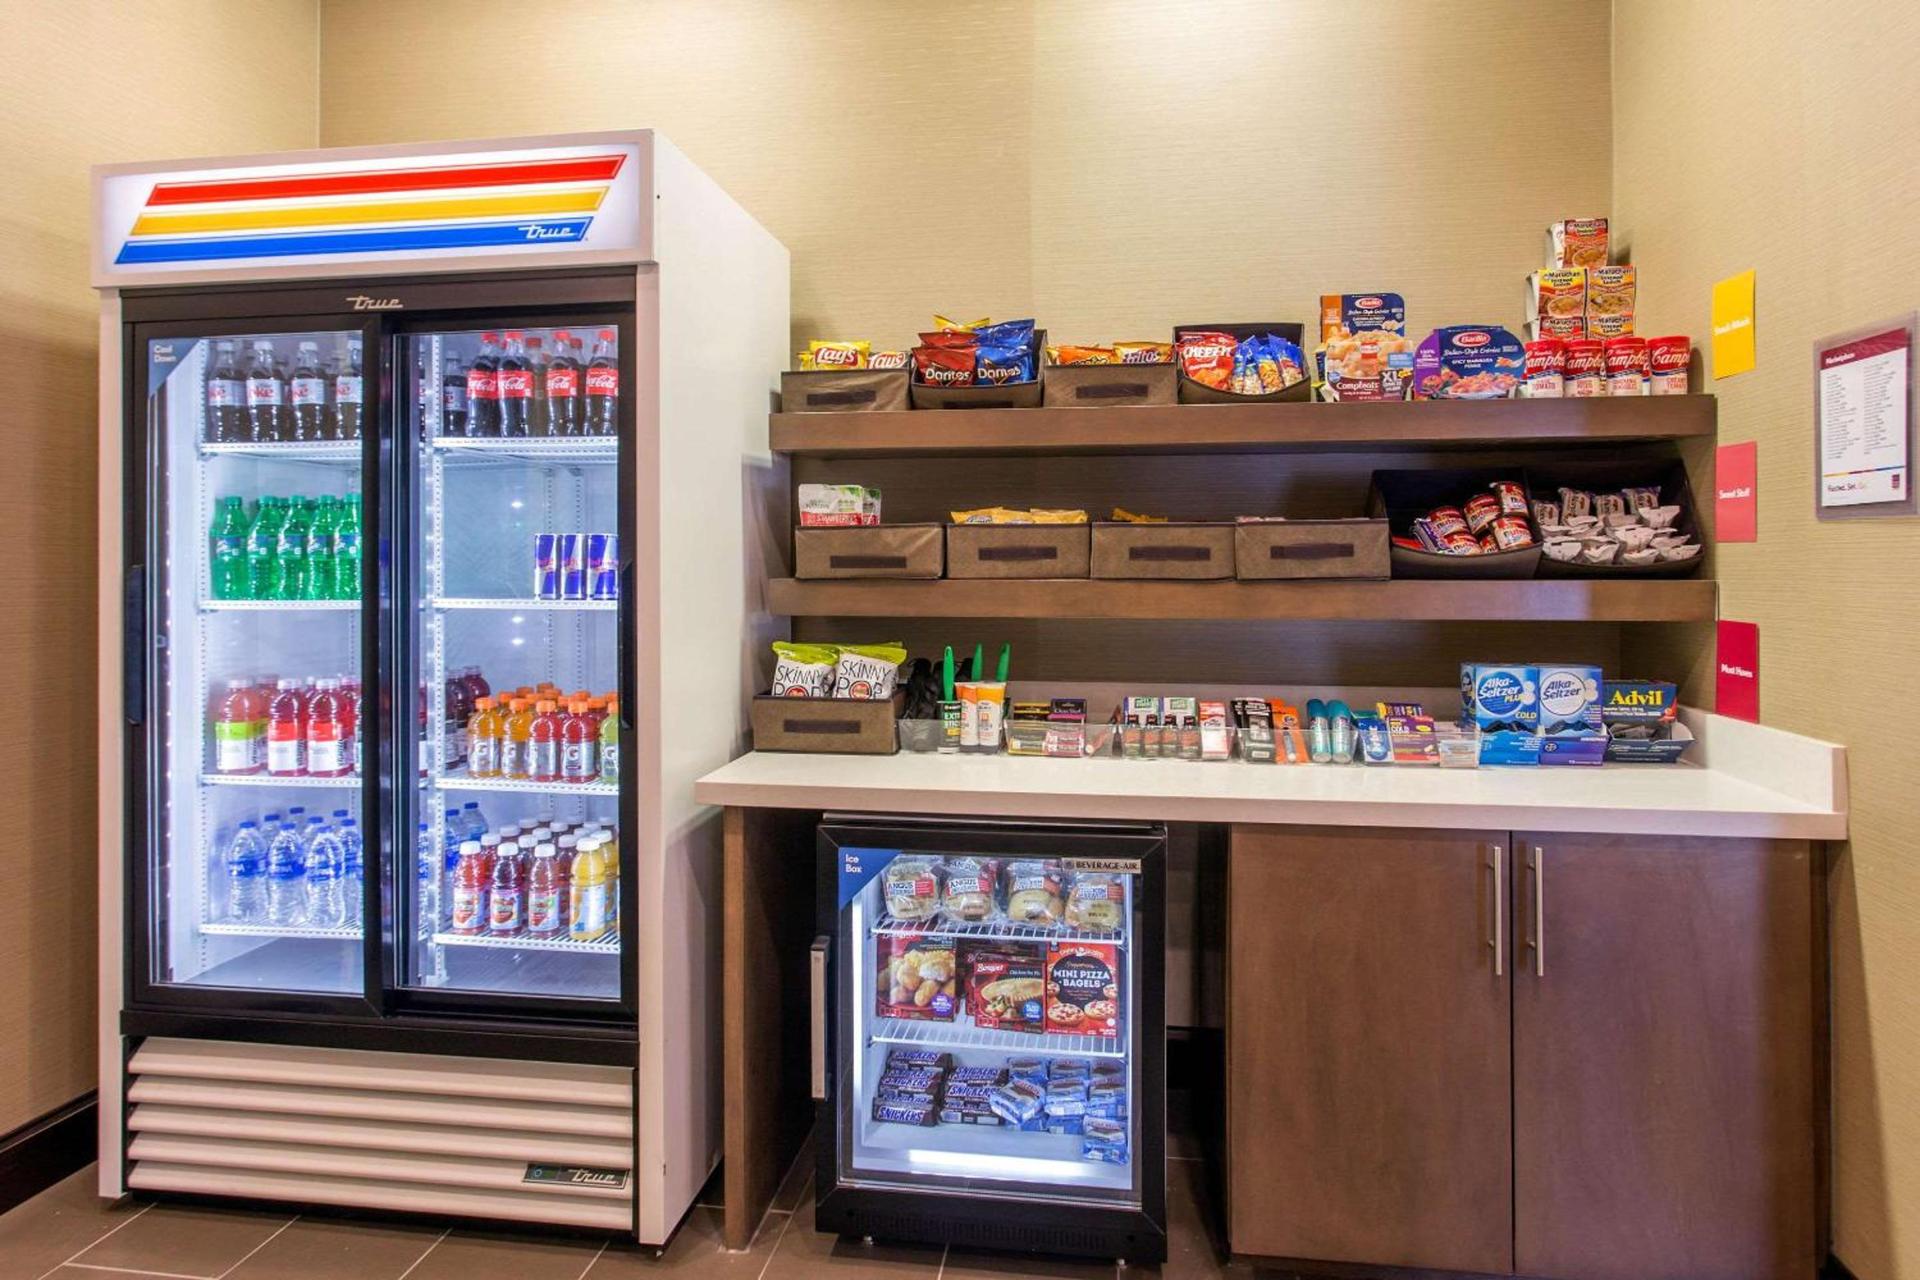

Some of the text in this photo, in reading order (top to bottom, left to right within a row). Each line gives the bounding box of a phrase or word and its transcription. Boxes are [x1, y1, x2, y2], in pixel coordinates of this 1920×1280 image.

[518, 225, 576, 239] true
[346, 296, 403, 310] true
[1461, 336, 1487, 344] Barilla
[1121, 350, 1160, 363] Fritos
[924, 367, 971, 382] Doritos
[776, 665, 823, 684] SKINNY
[840, 660, 891, 681] SKINNY
[1485, 678, 1513, 687] Alka-
[1547, 680, 1575, 689] Alka-
[1479, 686, 1521, 699] Seltzer
[1543, 688, 1581, 700] Seltzer
[1609, 690, 1663, 705] Advil
[845, 854, 859, 863] Ice
[845, 864, 862, 873] Box
[1076, 861, 1138, 870] BEVERAGE-AIR
[1053, 969, 1110, 979] MINI PIZZA
[1063, 979, 1100, 988] BAGELS
[879, 1106, 924, 1121] SNICKERS
